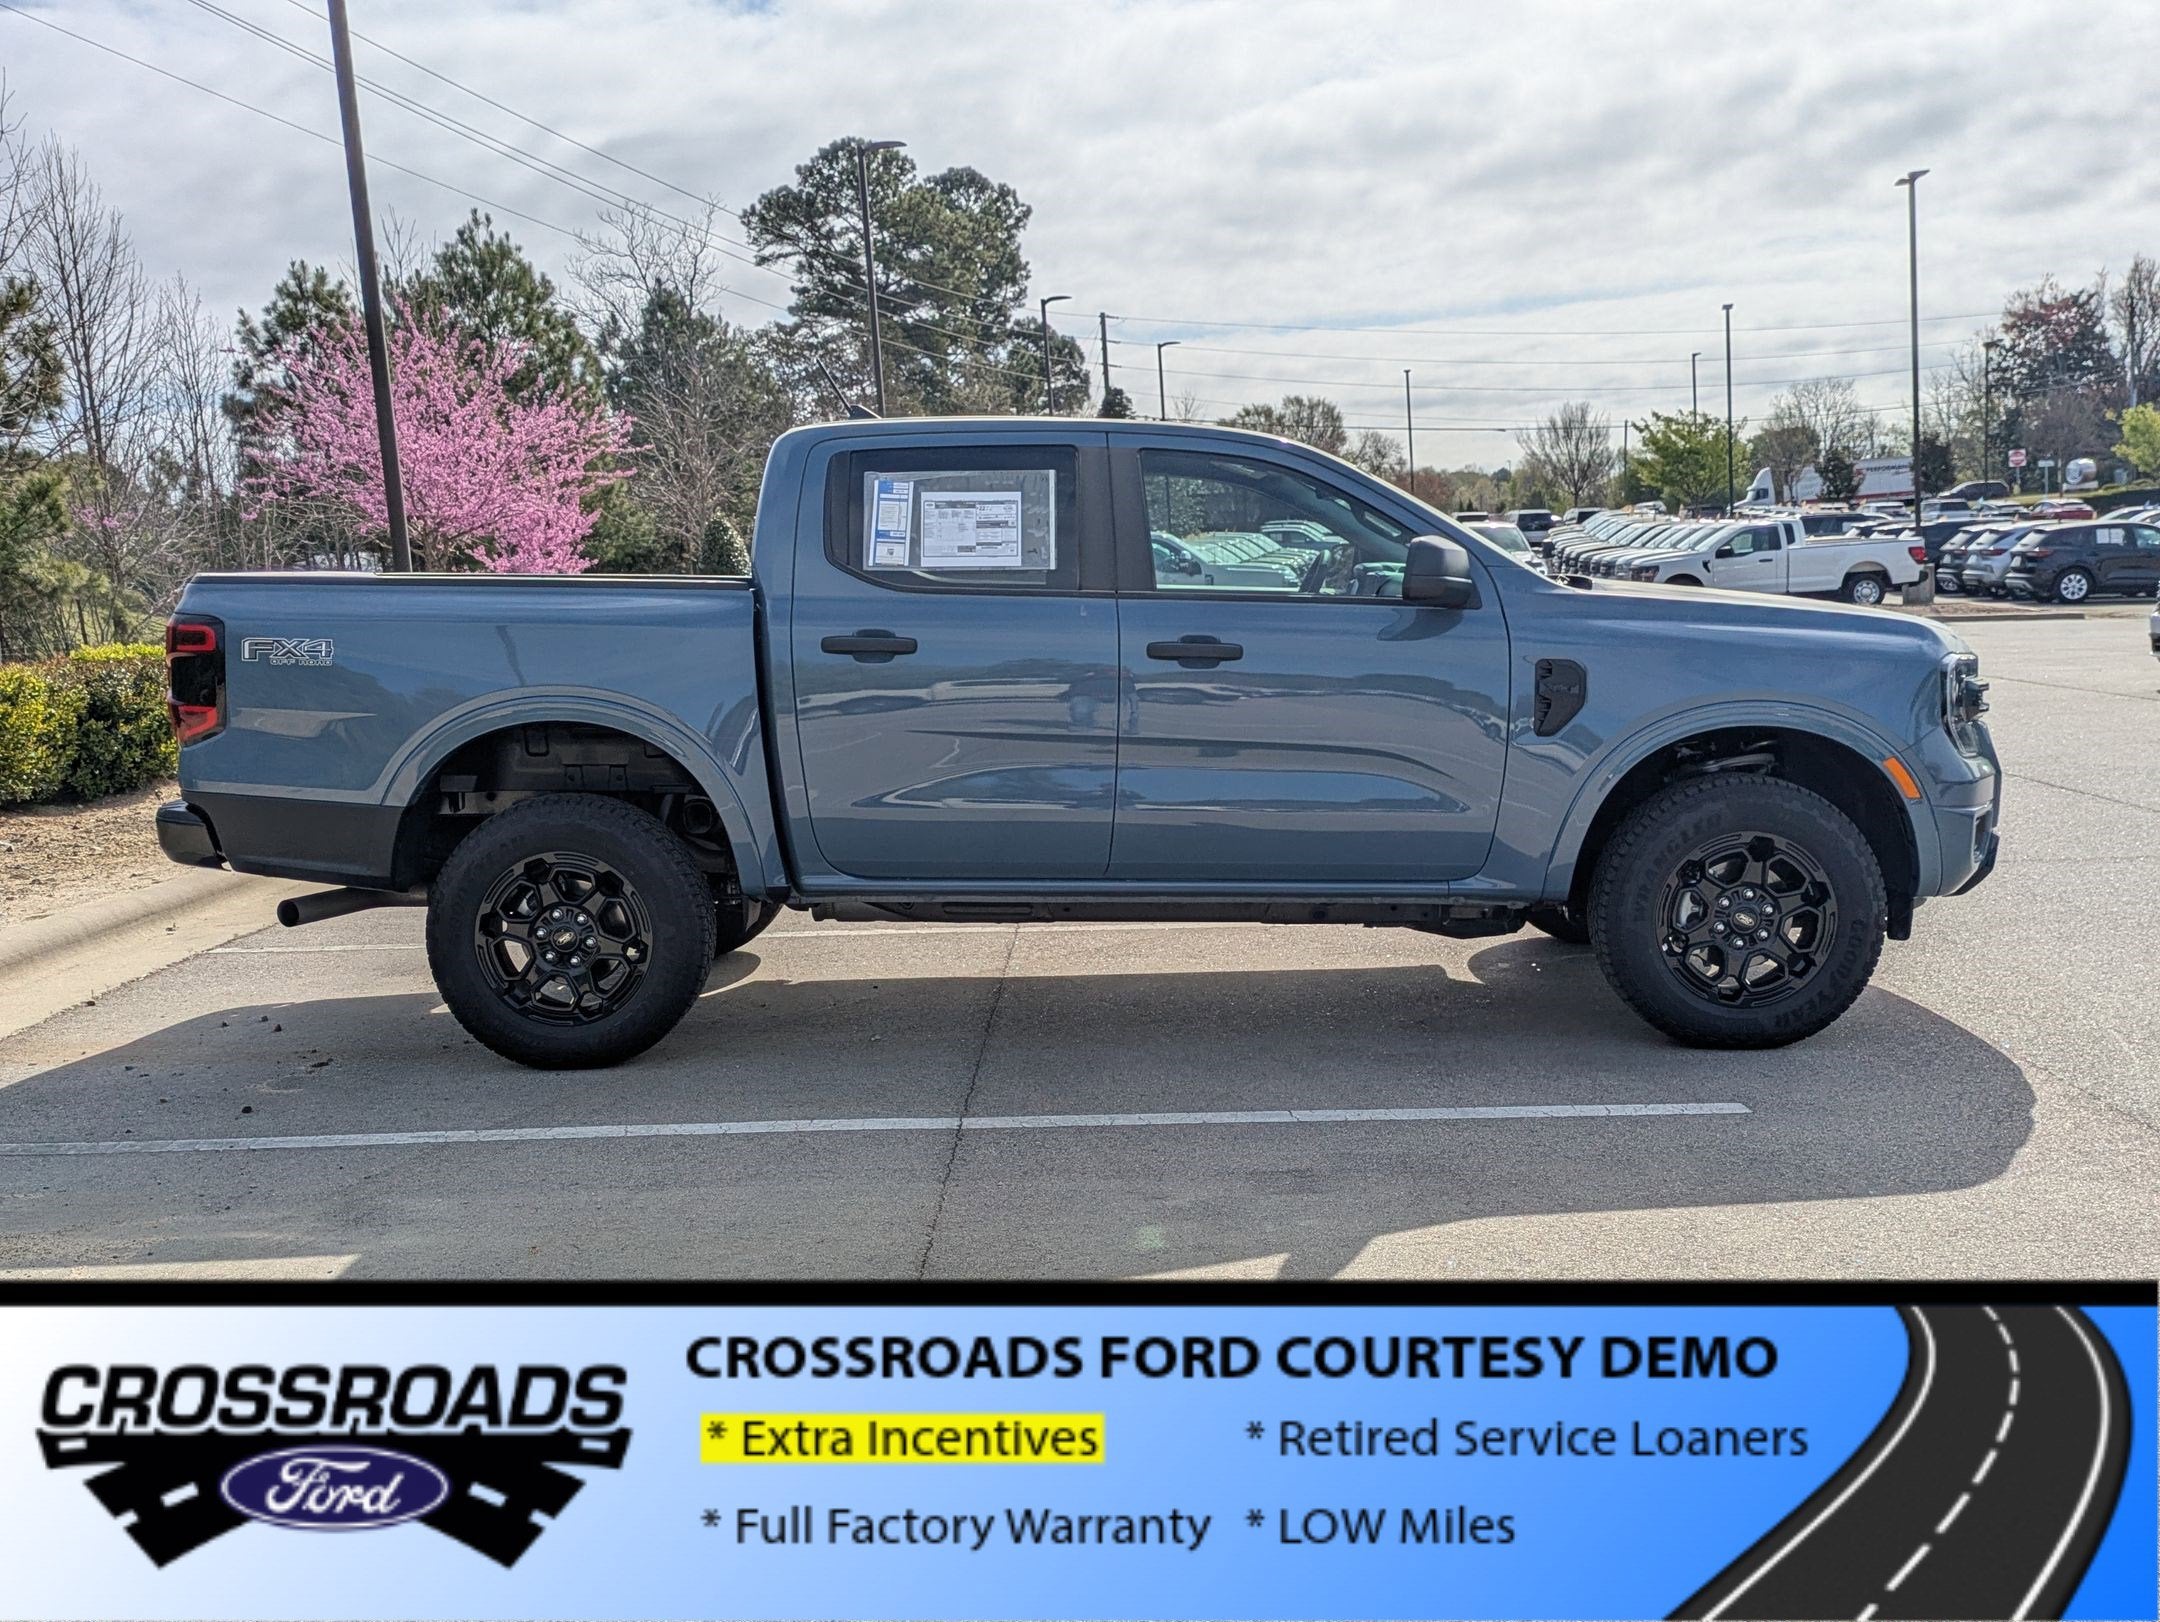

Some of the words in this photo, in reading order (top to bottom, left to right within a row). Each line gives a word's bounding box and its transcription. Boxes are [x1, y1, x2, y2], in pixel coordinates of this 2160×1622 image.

[241, 637, 335, 662] FX4
[269, 658, 296, 666] OFF
[298, 658, 333, 666] ROAD
